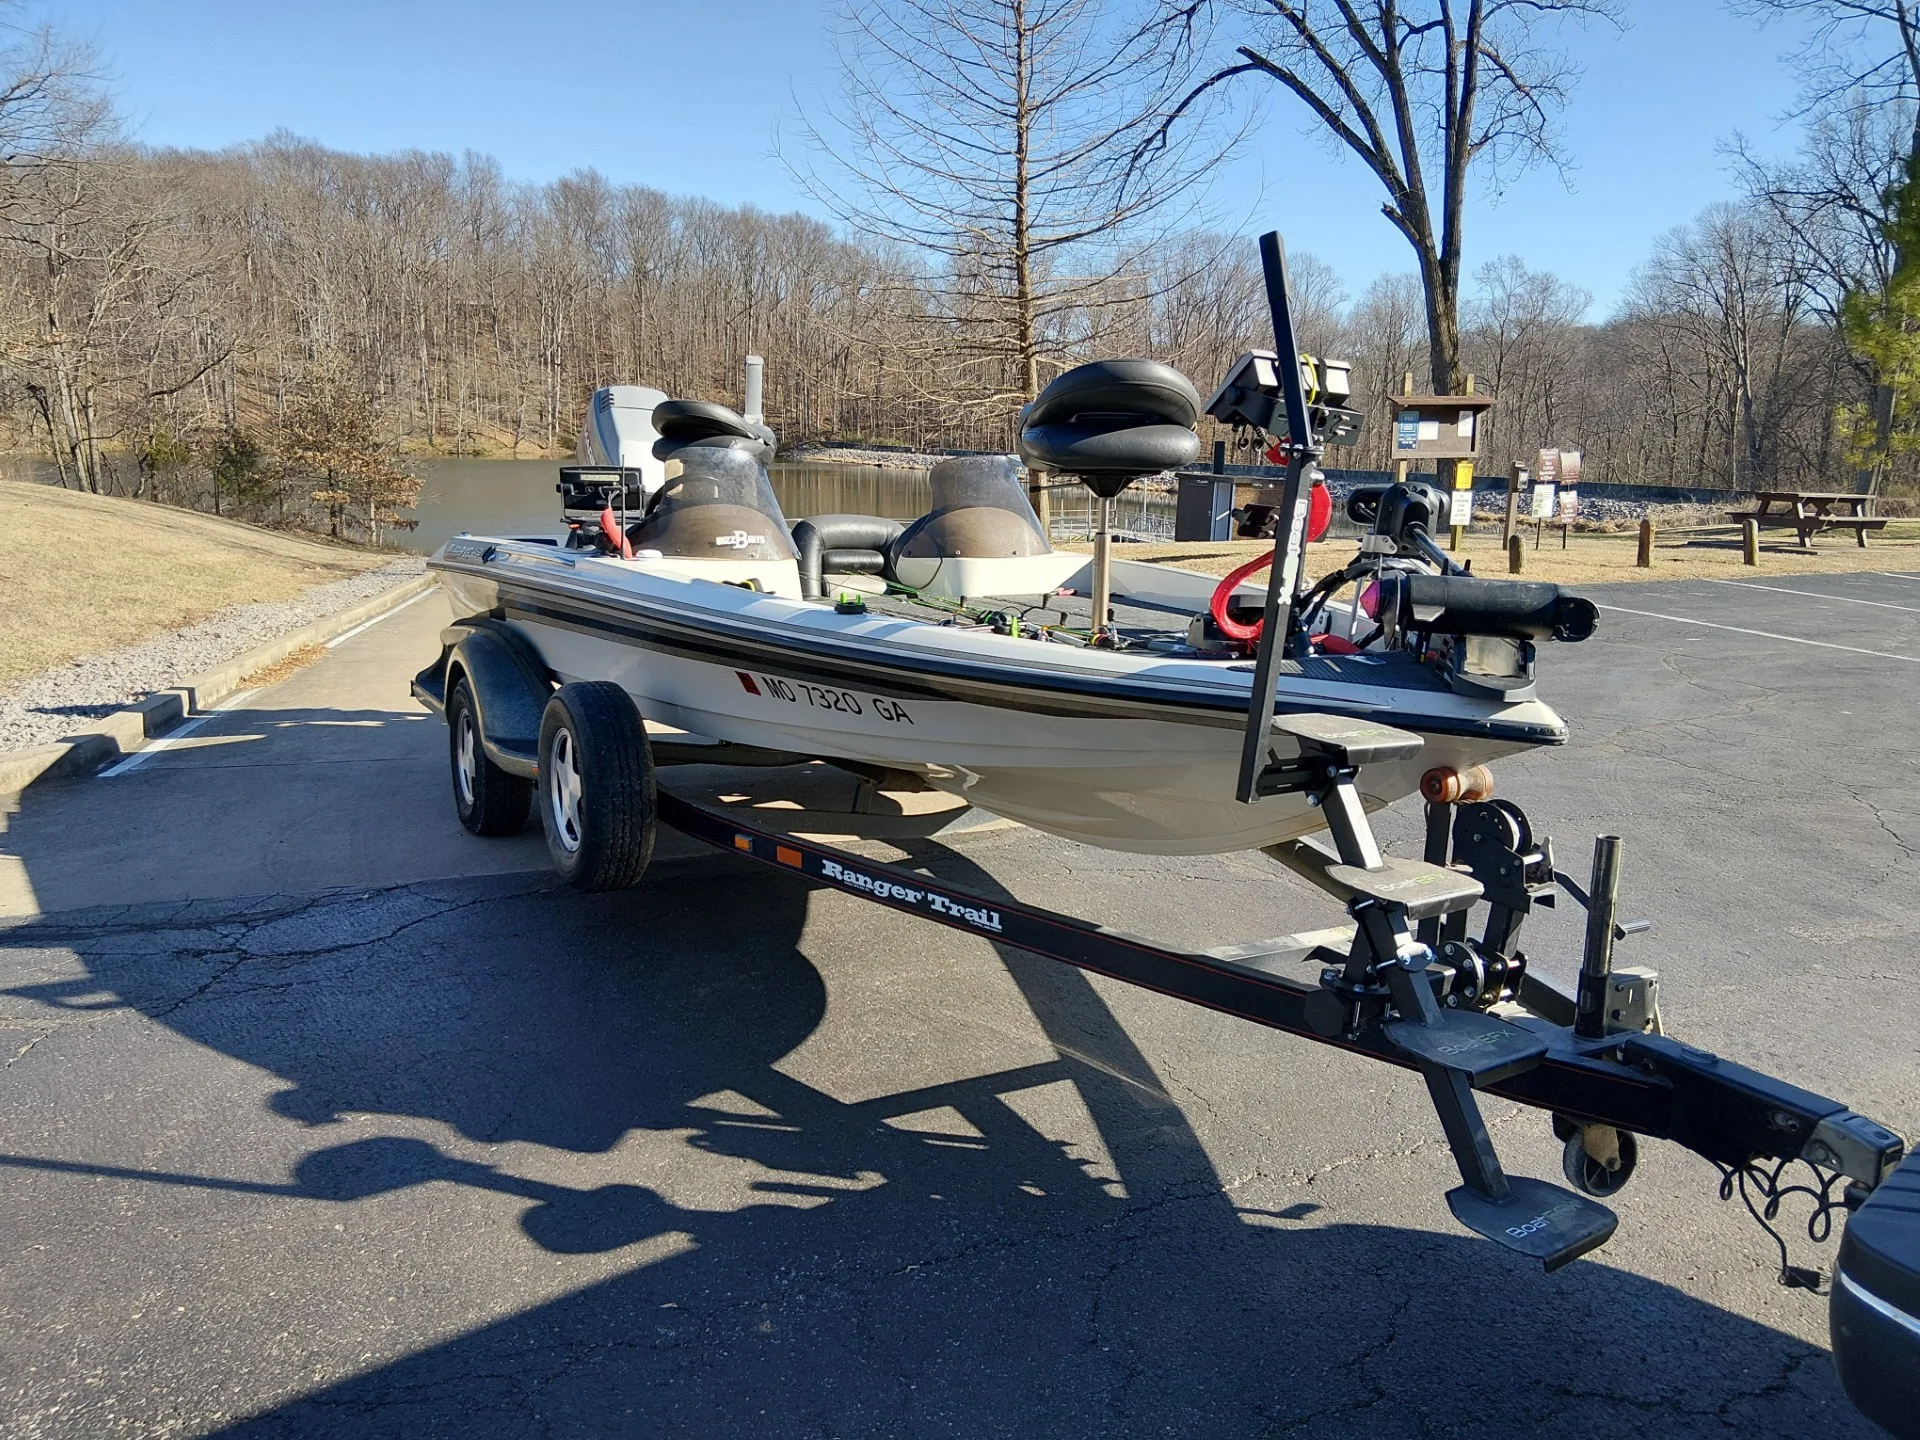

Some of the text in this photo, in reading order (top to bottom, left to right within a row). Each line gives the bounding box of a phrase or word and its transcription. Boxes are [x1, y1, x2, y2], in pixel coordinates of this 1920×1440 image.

[761, 676, 915, 725] MO 7320 GA
[821, 859, 1003, 930] Ranger Trail
[1437, 1029, 1516, 1056] BoatEFX
